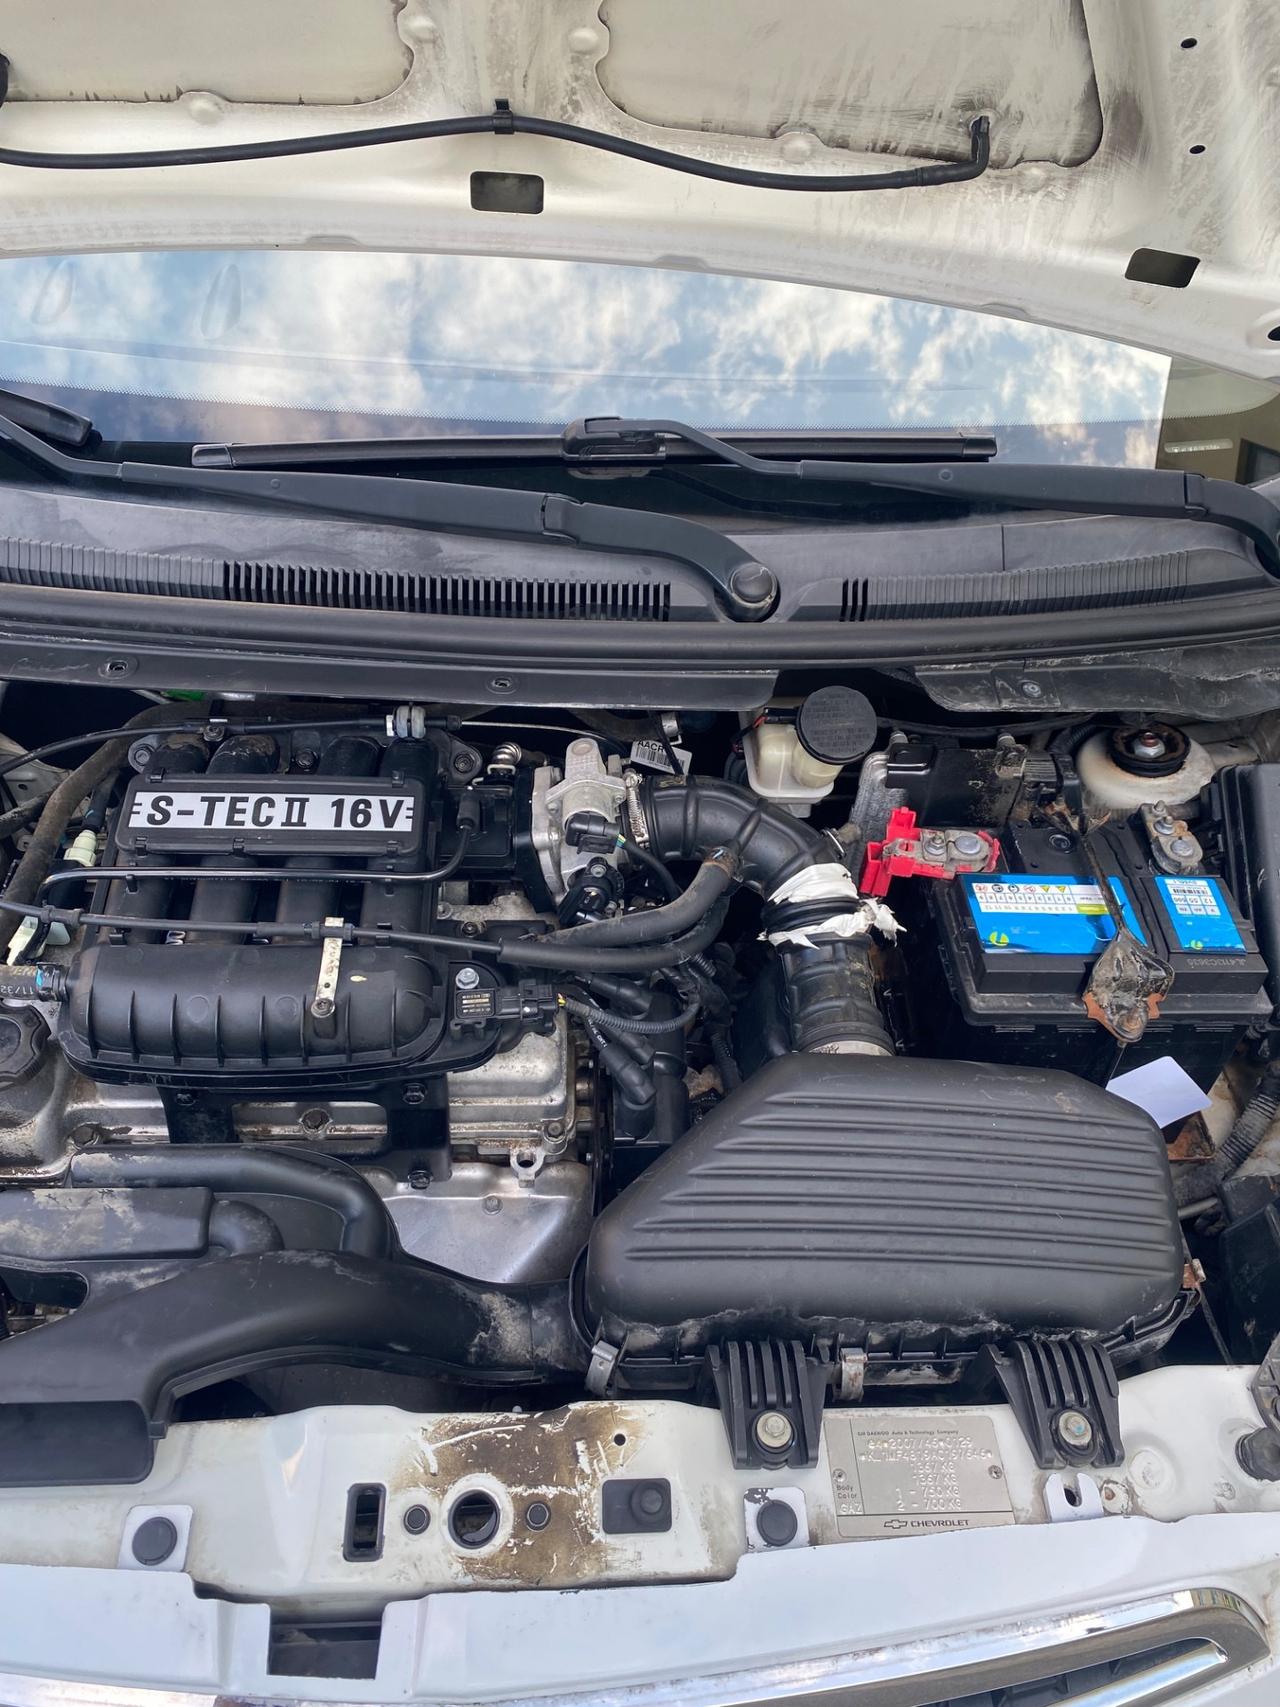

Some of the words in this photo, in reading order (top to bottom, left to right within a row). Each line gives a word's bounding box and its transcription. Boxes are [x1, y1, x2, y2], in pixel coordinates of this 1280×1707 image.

[330, 797, 404, 828] 16V
[941, 1461, 956, 1473] KG
[944, 1473, 957, 1485] KG
[946, 1486, 960, 1498] KG
[896, 1500, 905, 1511] 2
[948, 1499, 961, 1511] KG
[911, 1519, 969, 1528] CHEVROLET
